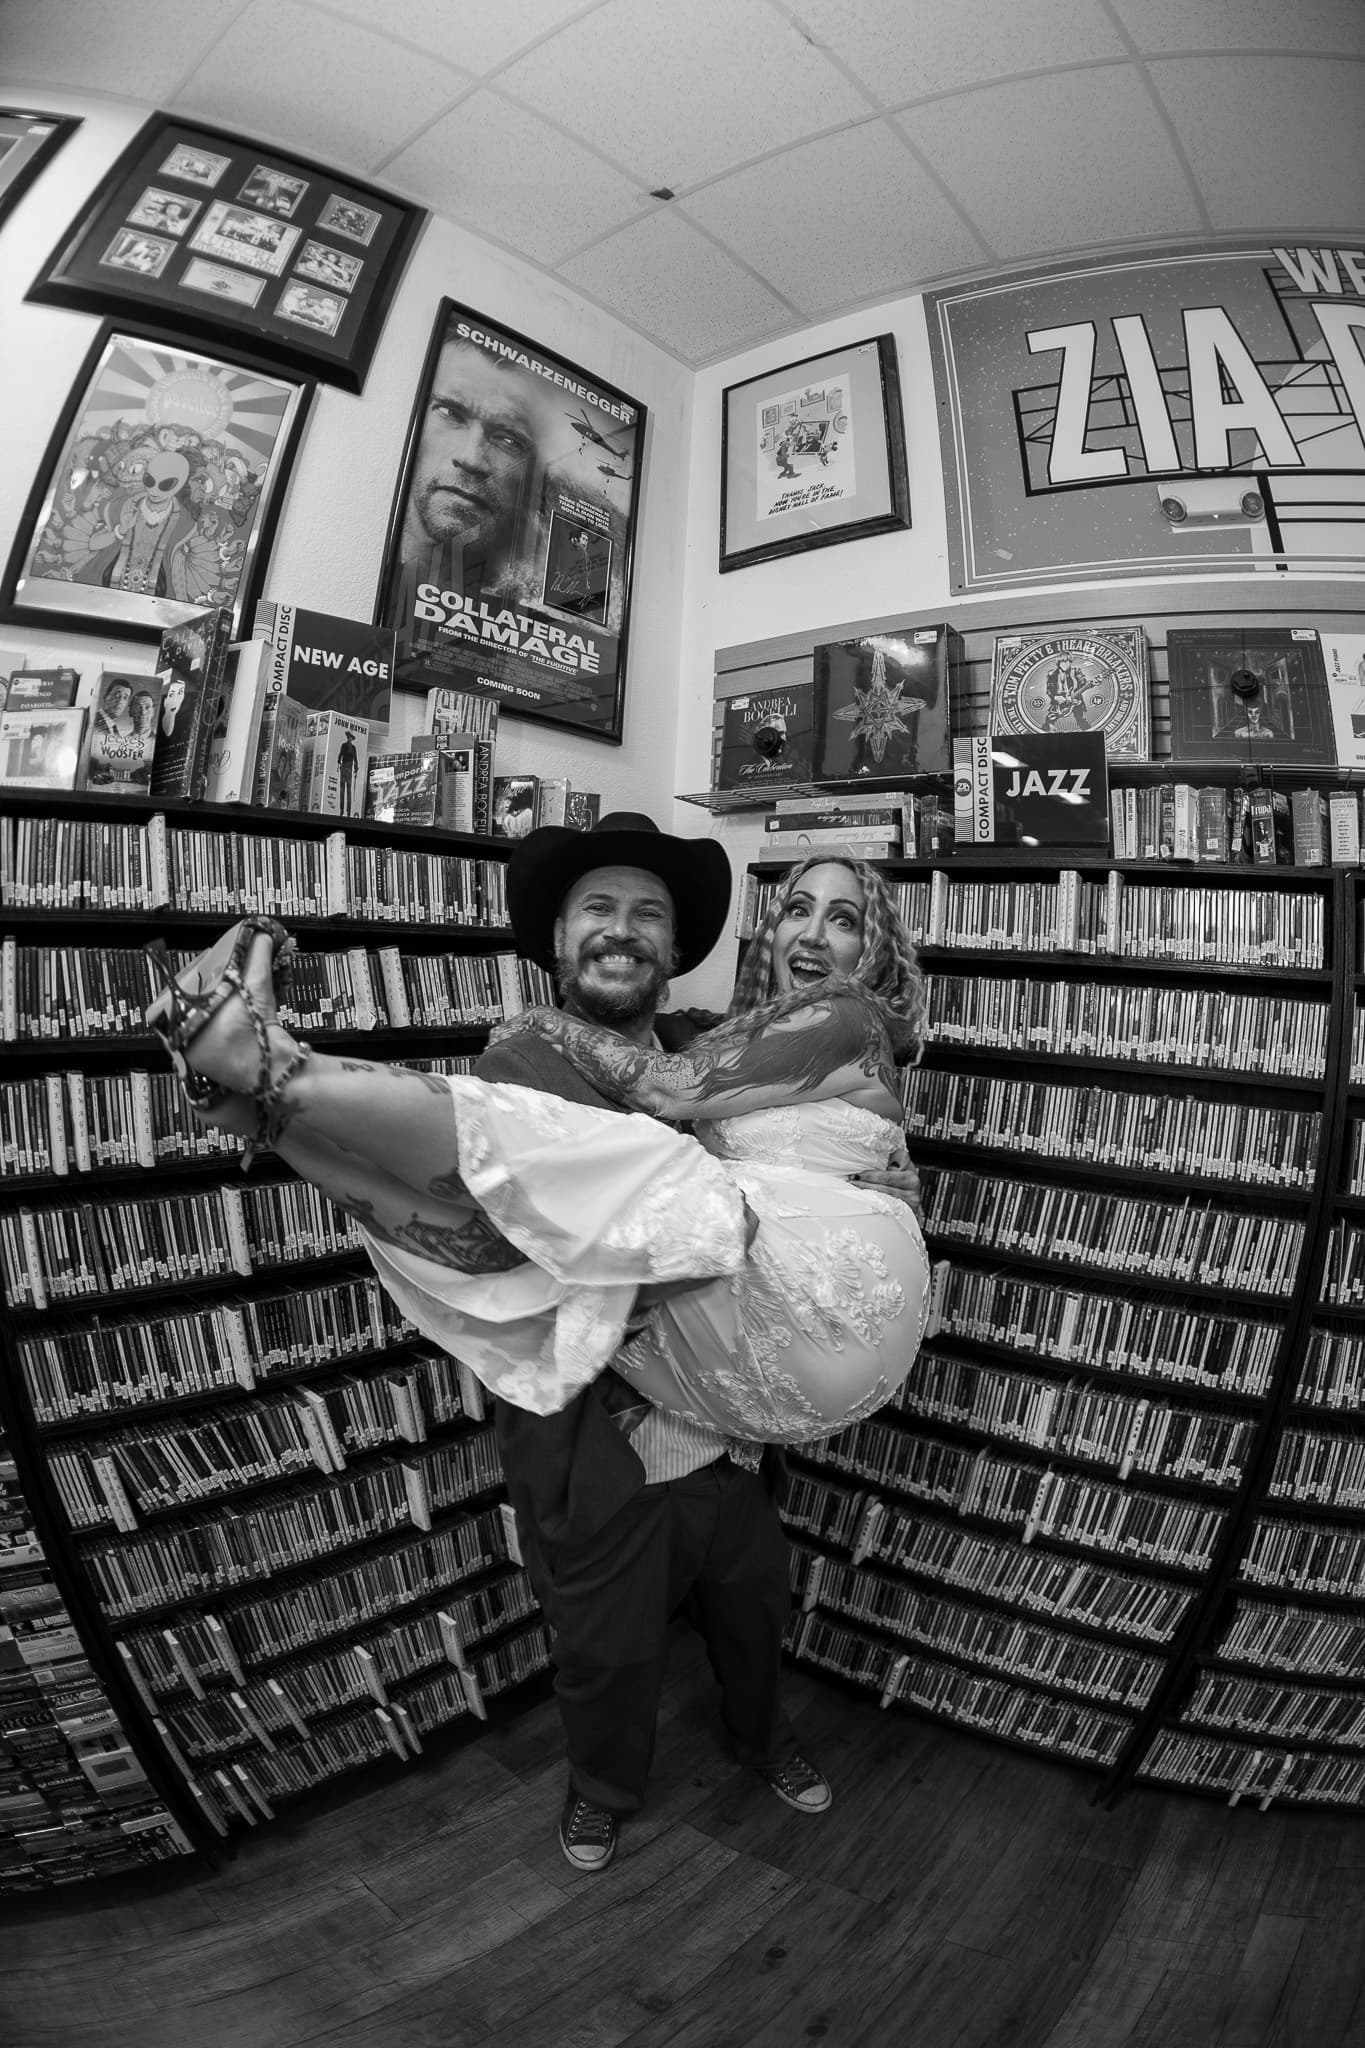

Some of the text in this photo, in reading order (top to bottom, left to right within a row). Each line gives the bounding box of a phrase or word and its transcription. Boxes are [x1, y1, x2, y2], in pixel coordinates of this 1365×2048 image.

[456, 323, 631, 424] SCHWARZENEGGER
[1026, 306, 1305, 485] ZIA
[414, 600, 600, 674] DAMAGE
[417, 583, 600, 658] COLLATERAL
[272, 605, 292, 692] OMPACT DISC
[438, 626, 462, 639] FROM
[463, 632, 478, 643] THE
[480, 638, 517, 653] DIRECTOR
[518, 650, 529, 658] OF
[294, 645, 389, 679] NEW AGE
[1004, 678, 1018, 697] TOM
[1015, 648, 1045, 676] PETTY
[1062, 638, 1134, 691] HEARTBREAKERS
[477, 676, 541, 700] COMING SOON
[752, 696, 792, 712] ANDREA
[335, 717, 348, 729] JOHN
[744, 703, 797, 722] BOCELLI
[101, 746, 144, 761] WOOSTER
[479, 745, 490, 790] ANDREA
[977, 737, 990, 839] COMPACT DISC
[1006, 769, 1091, 797] JAZZ
